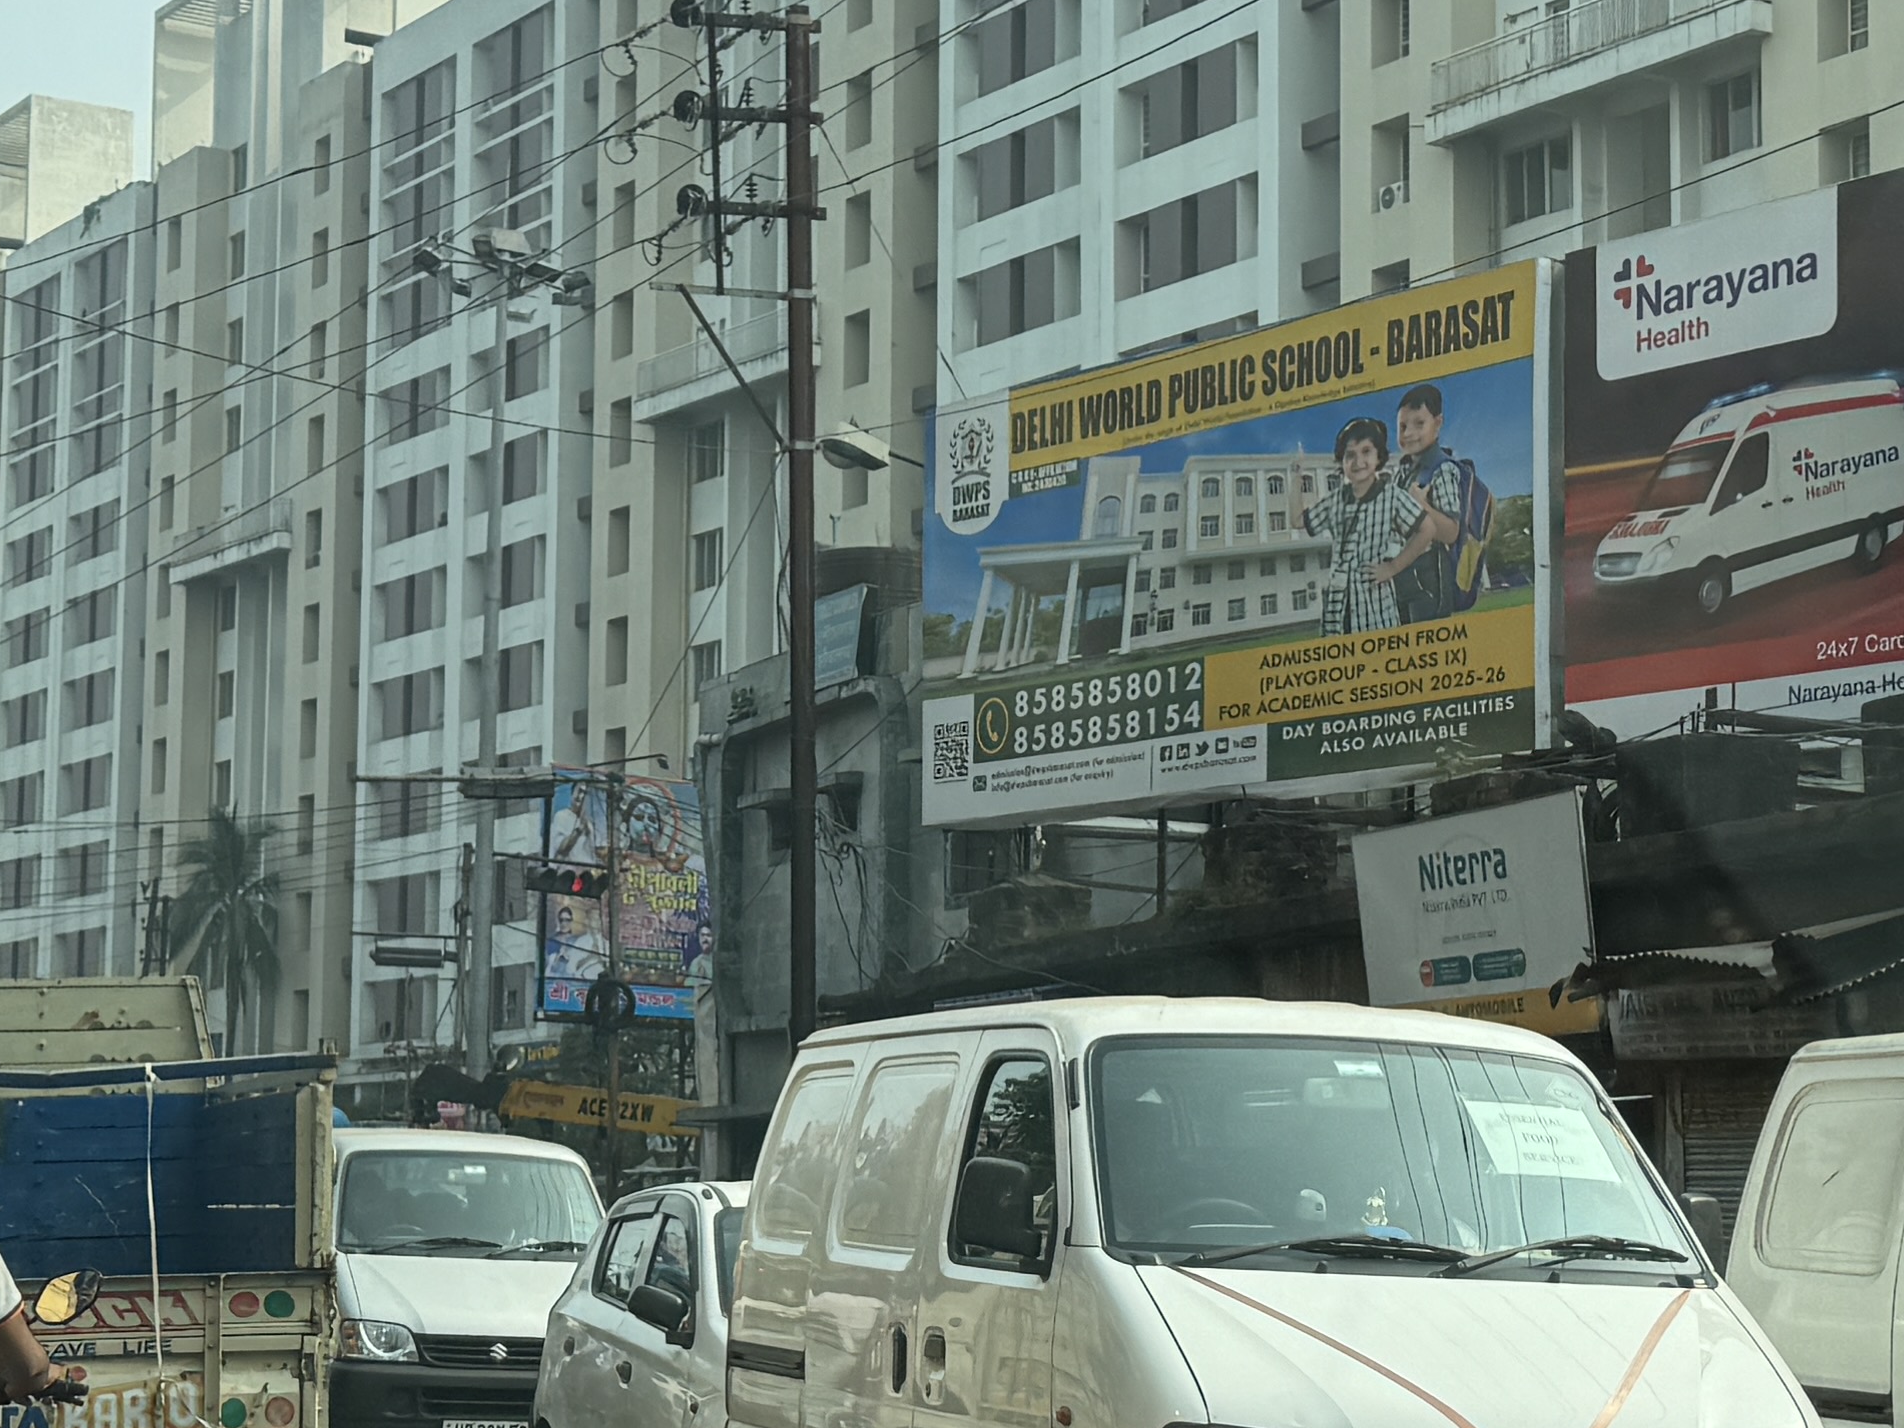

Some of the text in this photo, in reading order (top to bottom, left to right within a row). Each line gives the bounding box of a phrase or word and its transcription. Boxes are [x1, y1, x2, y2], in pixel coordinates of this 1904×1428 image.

[1636, 252, 1819, 321] Narayana
[1636, 317, 1710, 353] Health
[1011, 400, 1074, 454] DELHI
[1079, 379, 1162, 440] WORLD
[1168, 354, 1256, 419] PUBLIC
[1262, 329, 1364, 397] SCHOOL
[1386, 290, 1515, 366] BARASAT
[1804, 445, 1899, 483] Narayana
[952, 479, 991, 506] DWPS
[1806, 479, 1846, 501] Health
[952, 502, 991, 523] BARASAT
[1259, 623, 1469, 670] ADMISSION OPEN FROM
[1816, 638, 1859, 661] 24x7
[1259, 664, 1366, 695] (PLAYGROUP
[1385, 653, 1438, 673] CLASS
[1445, 647, 1468, 667] IX)
[1014, 662, 1202, 718] 8585858012
[1219, 666, 1506, 721] FOR ACADEMIC SESSION 2025-26
[1788, 681, 1877, 706] Narayana
[1013, 700, 1201, 754] 8585858154
[1282, 695, 1516, 741] DAY BOARDING FACILITIES
[1319, 722, 1469, 755] ALSO AVAILABLE
[1418, 848, 1507, 892] Niterra
[577, 1097, 608, 1118] ACE
[615, 1099, 655, 1123] 2XW
[1522, 1131, 1559, 1145] FOOD
[122, 1339, 172, 1356] LIFE
